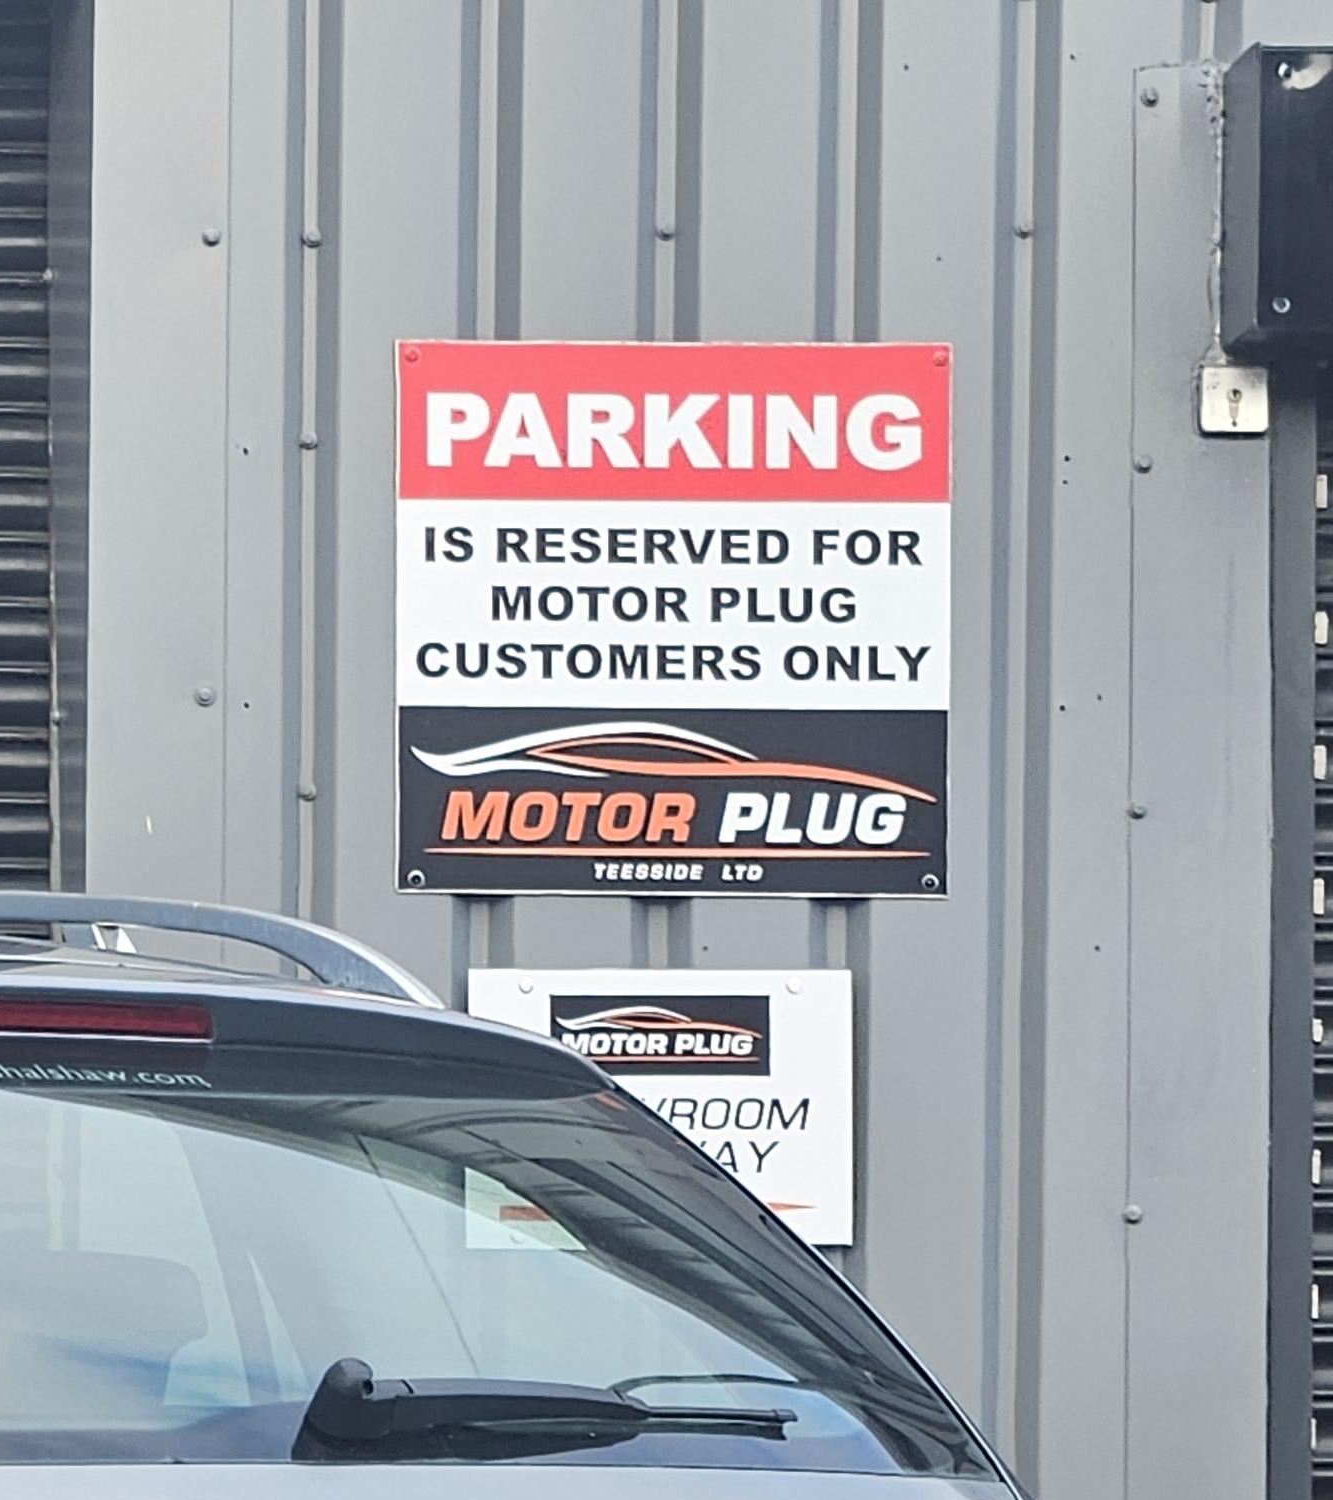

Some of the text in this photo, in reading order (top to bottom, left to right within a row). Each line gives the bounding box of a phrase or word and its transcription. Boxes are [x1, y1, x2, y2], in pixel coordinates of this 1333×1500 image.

[426, 391, 923, 471] PARKING
[423, 526, 922, 567] IS RESERVED FOR
[491, 586, 857, 624] MOTOR PLUG
[416, 643, 931, 682] CUSTOMERS ONLY
[441, 790, 907, 845] MOTOR PLUG
[593, 862, 763, 882] TEESSIDE LTD
[561, 1032, 754, 1056] MOTOR PLUG
[700, 1140, 780, 1173] AY
